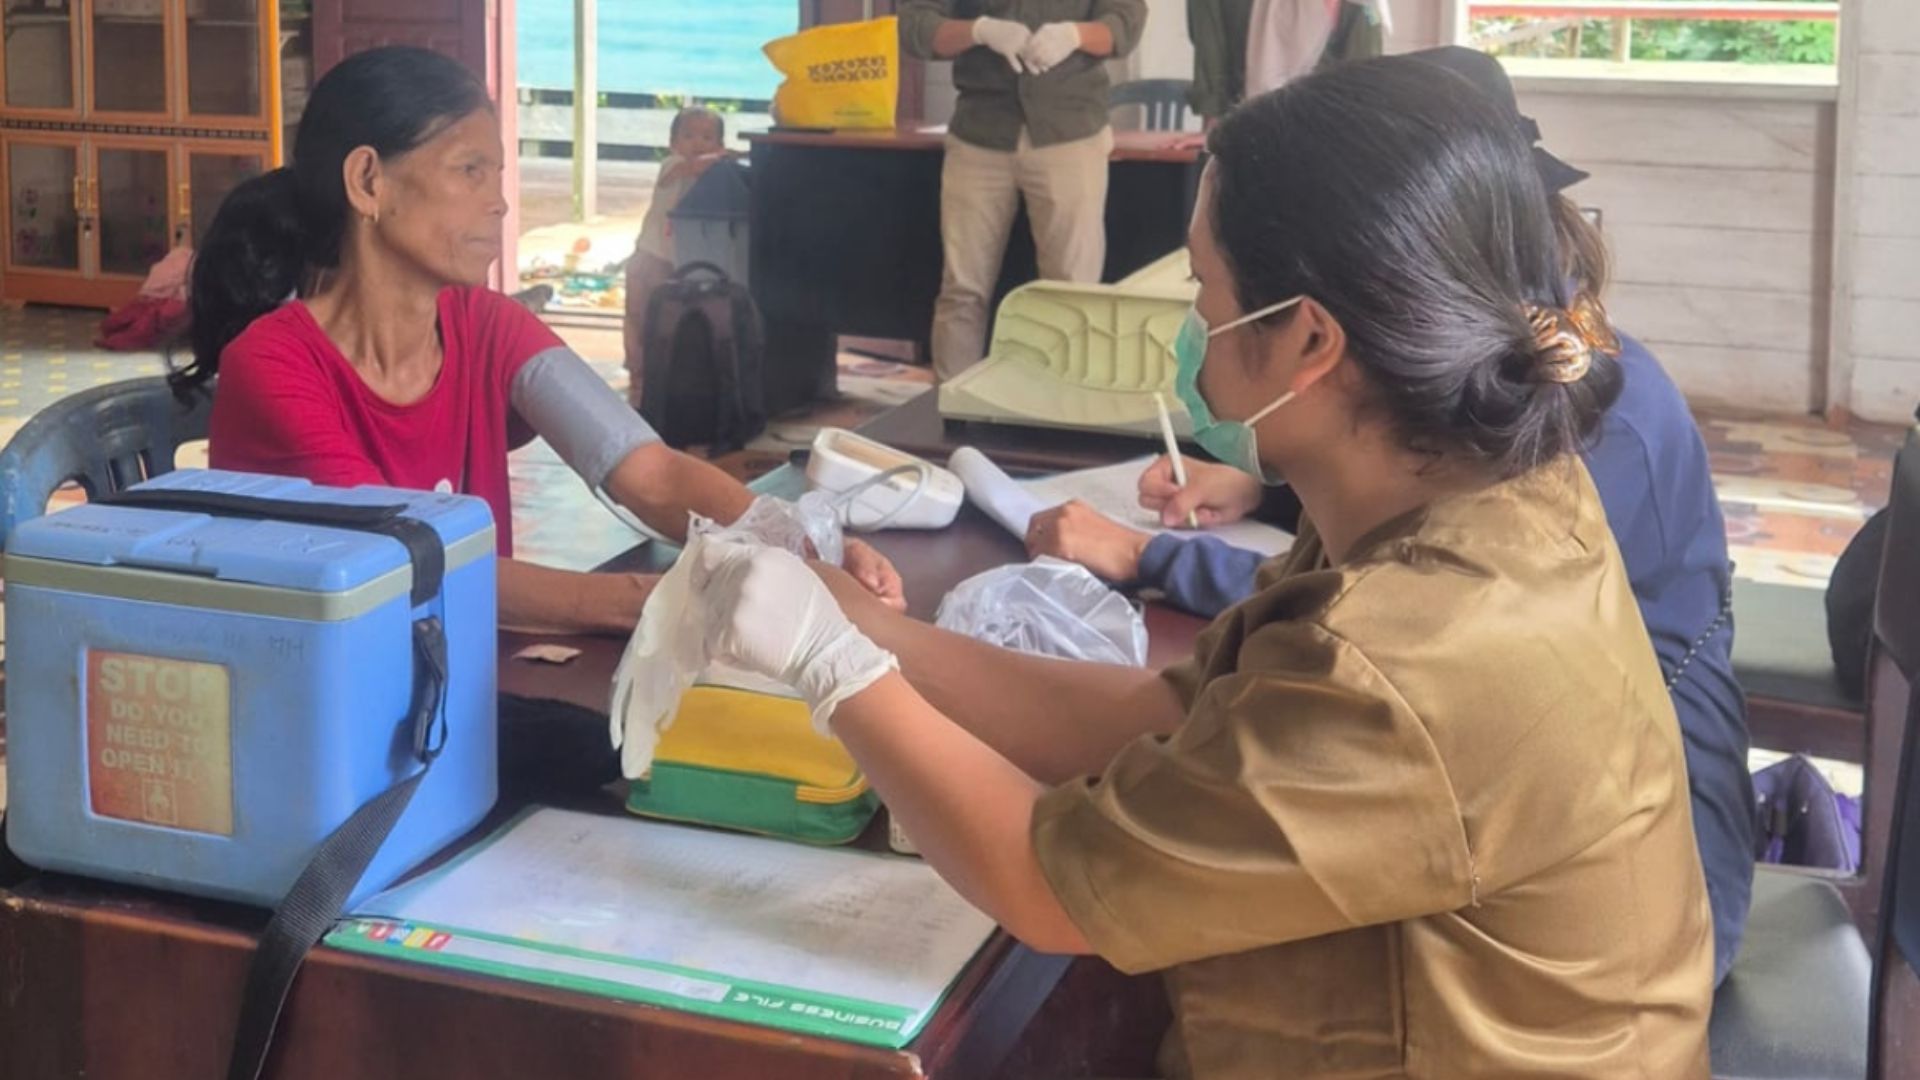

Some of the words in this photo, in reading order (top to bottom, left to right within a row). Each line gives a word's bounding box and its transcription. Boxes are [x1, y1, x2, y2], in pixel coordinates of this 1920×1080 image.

[101, 657, 216, 704] STOP
[111, 699, 143, 721] DO
[150, 704, 203, 730] YOU
[105, 724, 170, 749] NEED
[101, 747, 165, 775] OPEN
[732, 991, 785, 1009] FILE
